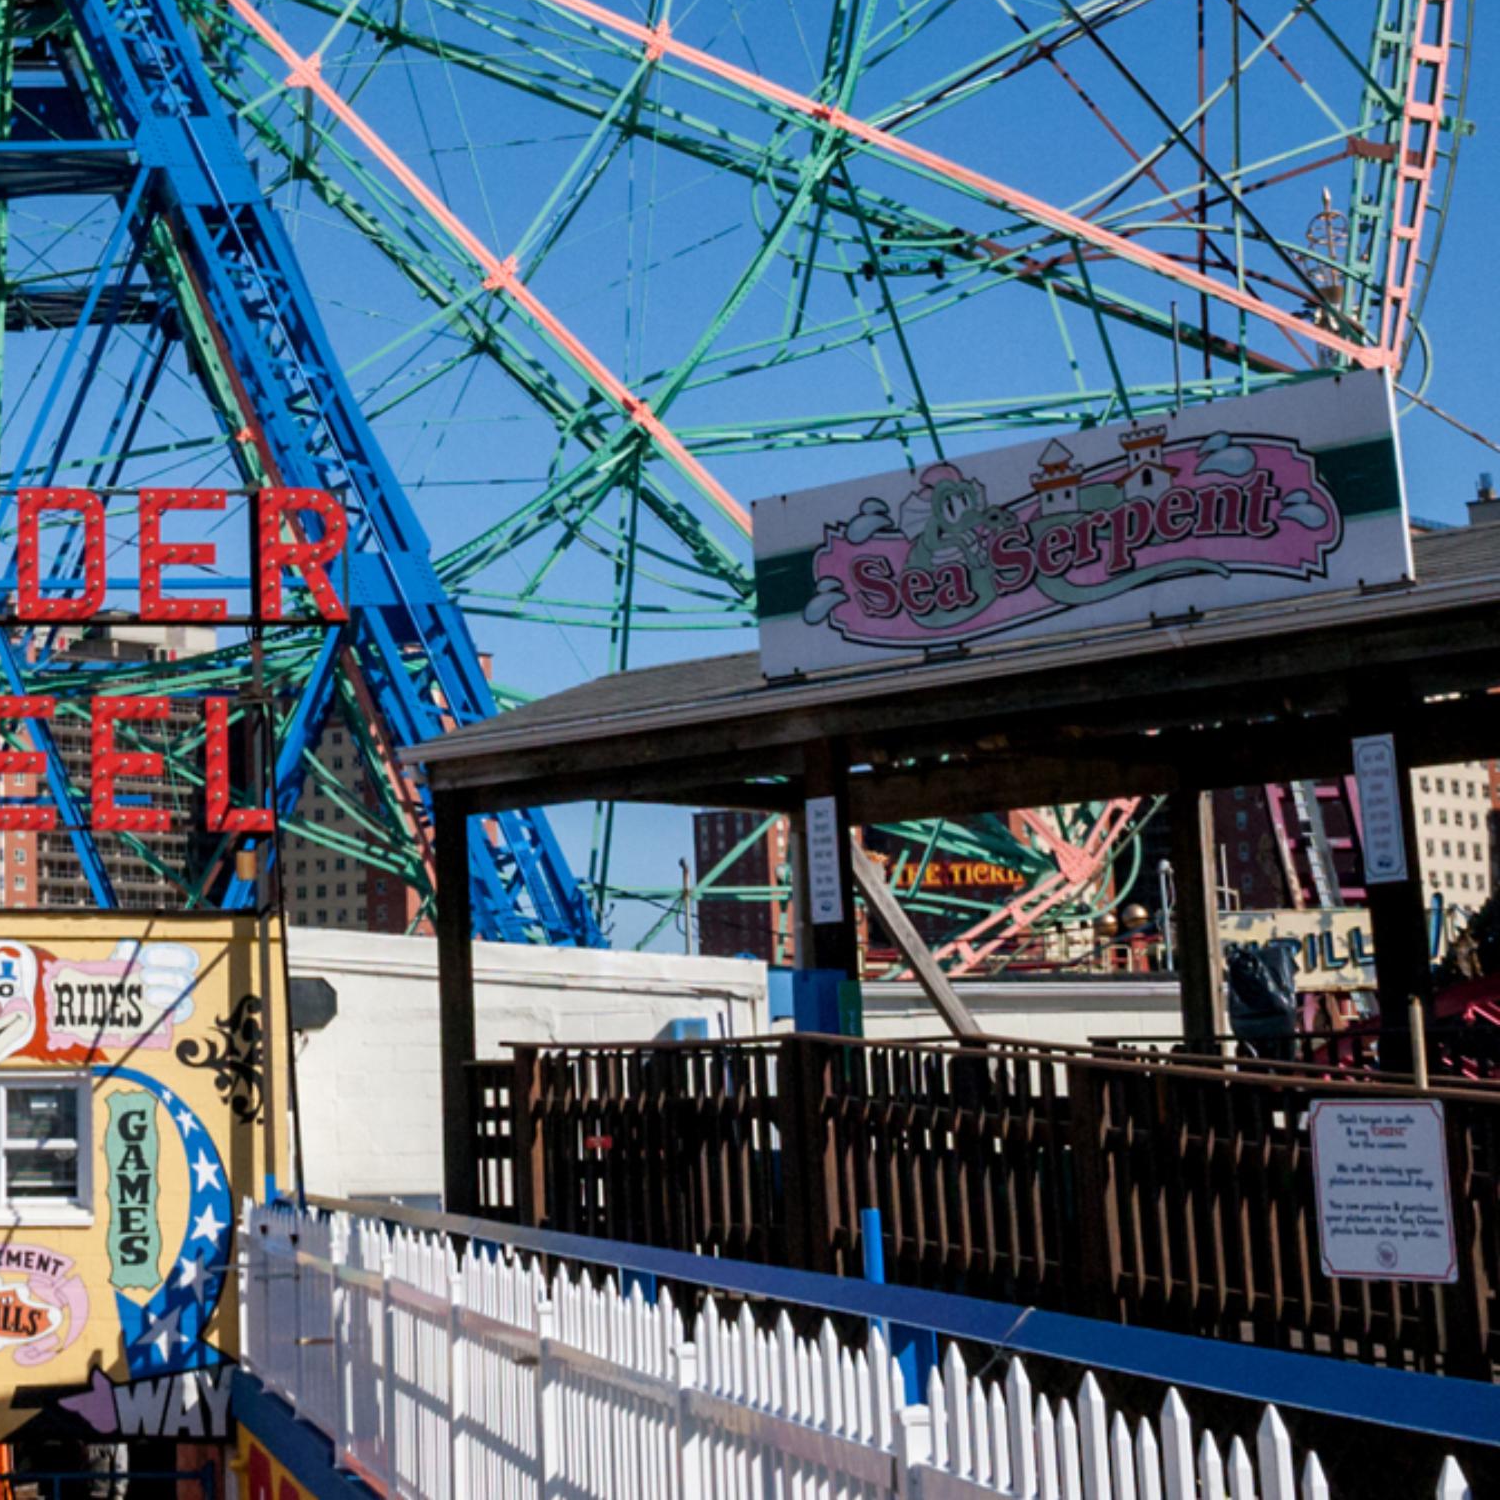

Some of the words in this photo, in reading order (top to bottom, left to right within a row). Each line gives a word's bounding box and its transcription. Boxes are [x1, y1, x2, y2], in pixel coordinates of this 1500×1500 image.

[850, 553, 977, 618] Sea
[989, 470, 1279, 595] Serpent
[54, 982, 143, 1027] RIDES
[118, 1111, 152, 1266] GAMES
[114, 1364, 235, 1437] WAY
